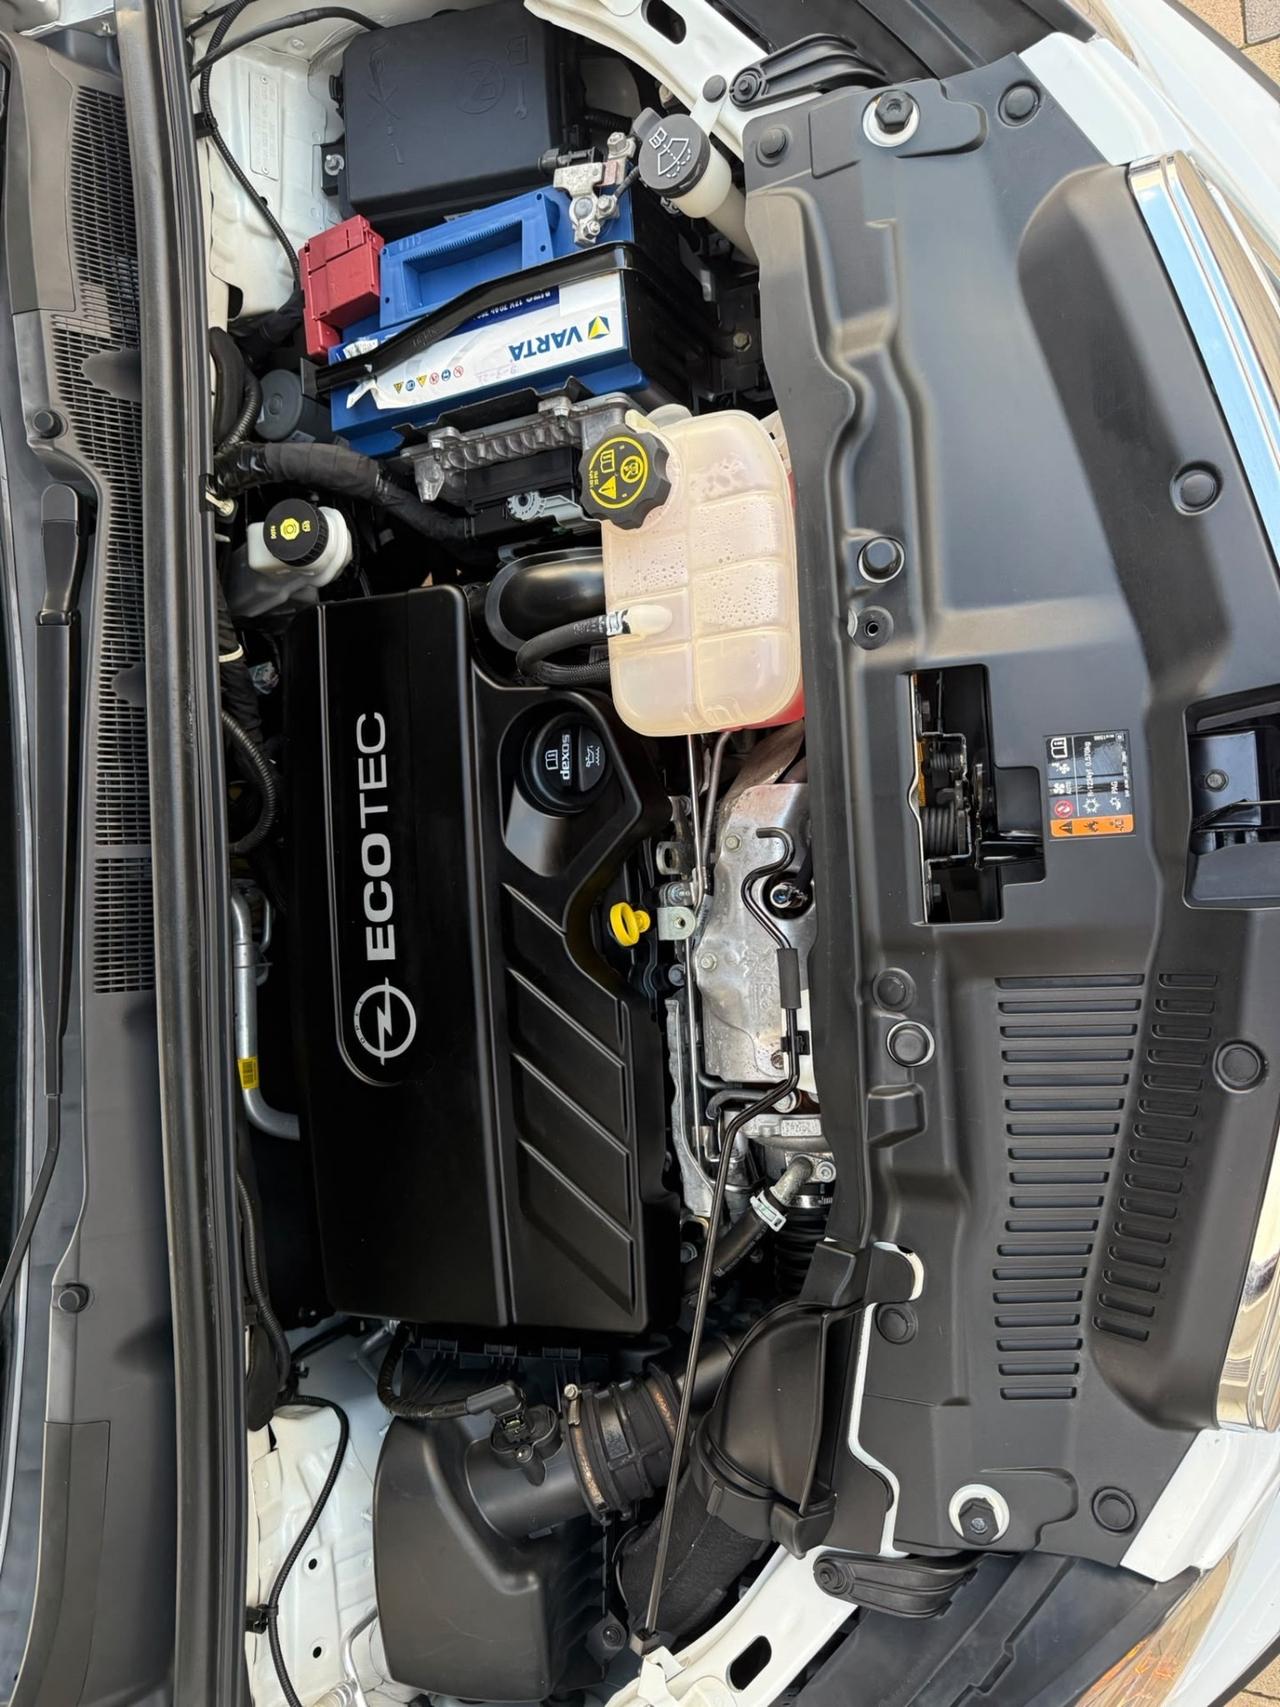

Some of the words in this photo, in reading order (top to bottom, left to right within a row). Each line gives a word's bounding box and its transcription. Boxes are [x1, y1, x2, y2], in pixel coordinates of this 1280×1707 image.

[507, 326, 583, 362] VARTA
[560, 734, 571, 780] dexos
[356, 712, 395, 960] ECOTEC
[354, 1000, 366, 1044] OPEL
